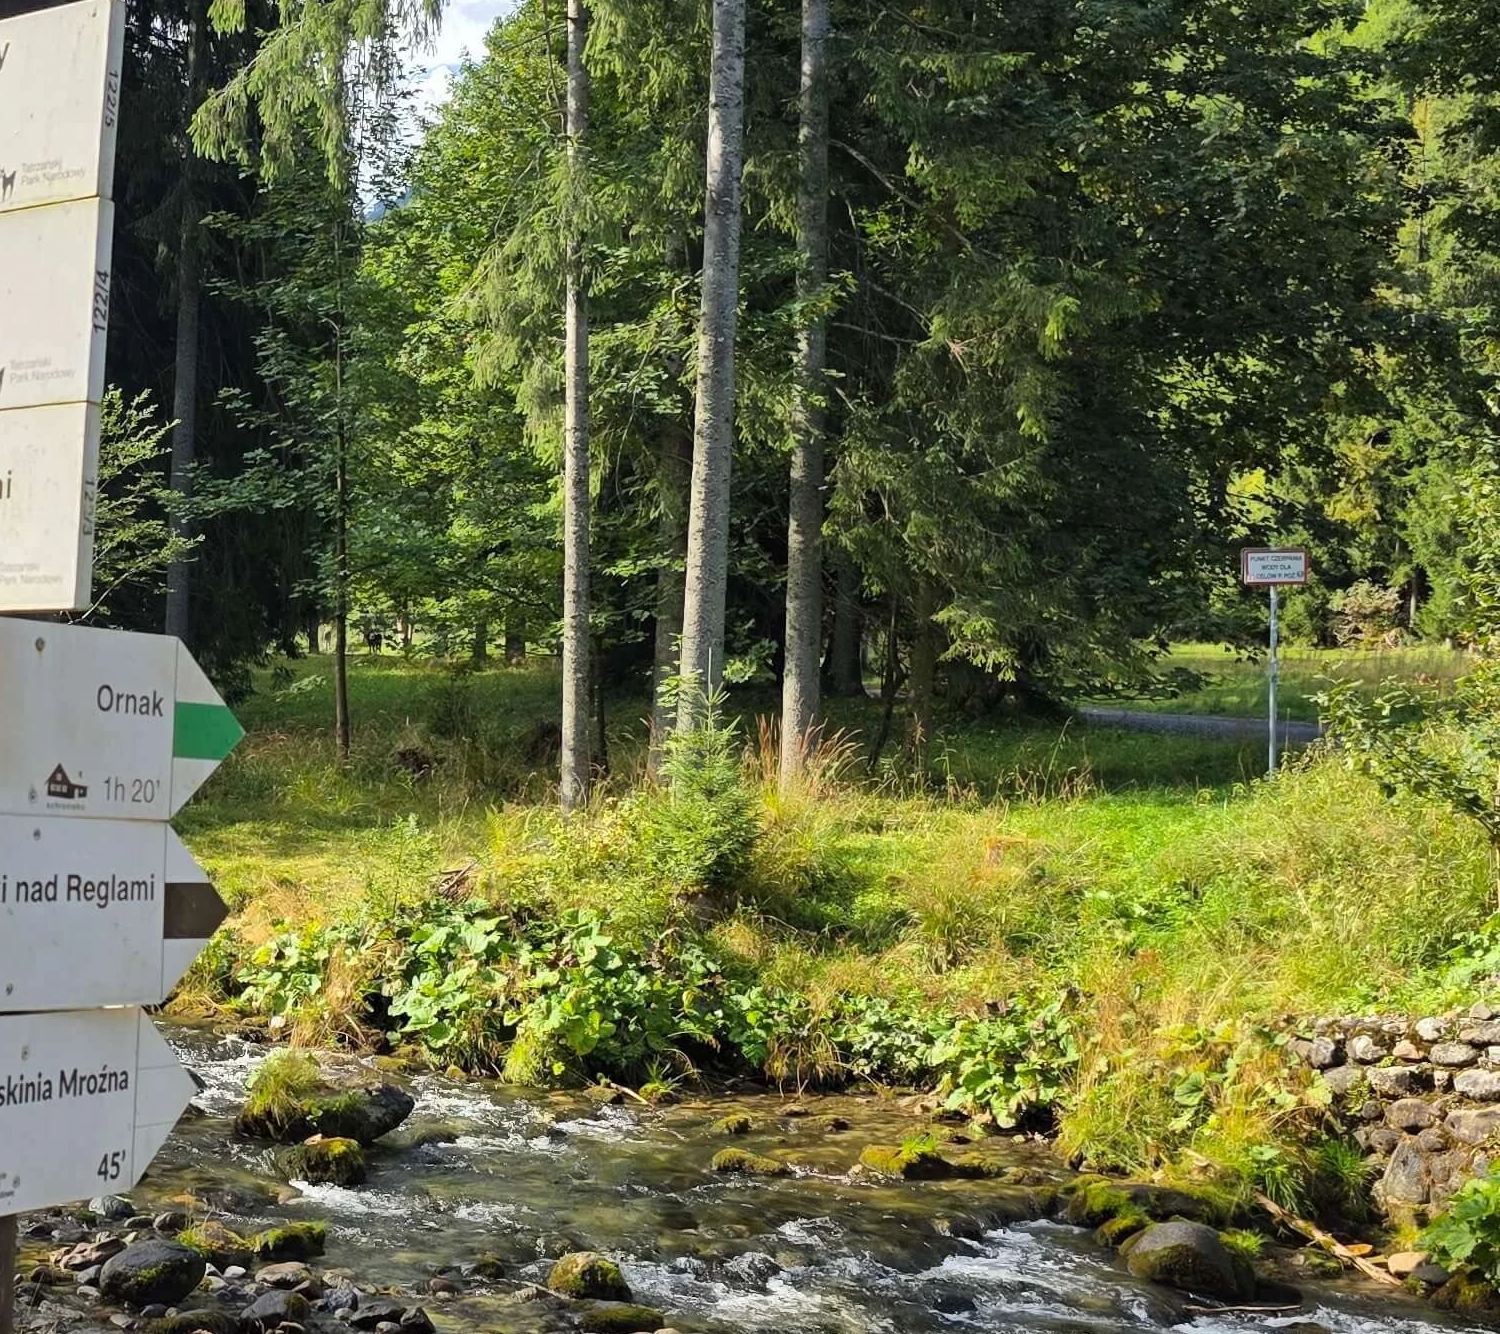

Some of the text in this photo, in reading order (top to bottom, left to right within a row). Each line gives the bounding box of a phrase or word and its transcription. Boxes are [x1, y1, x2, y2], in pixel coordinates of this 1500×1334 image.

[105, 70, 119, 128] 122/5
[21, 173, 40, 186] Park
[93, 269, 110, 333] 122/4
[10, 371, 28, 384] Park
[97, 684, 164, 717] Ornak
[103, 777, 161, 804] 1h 20'
[15, 874, 57, 903] nad
[66, 873, 155, 908] Reglami
[59, 1065, 129, 1099] Mroźna
[97, 1151, 126, 1182] 45'
